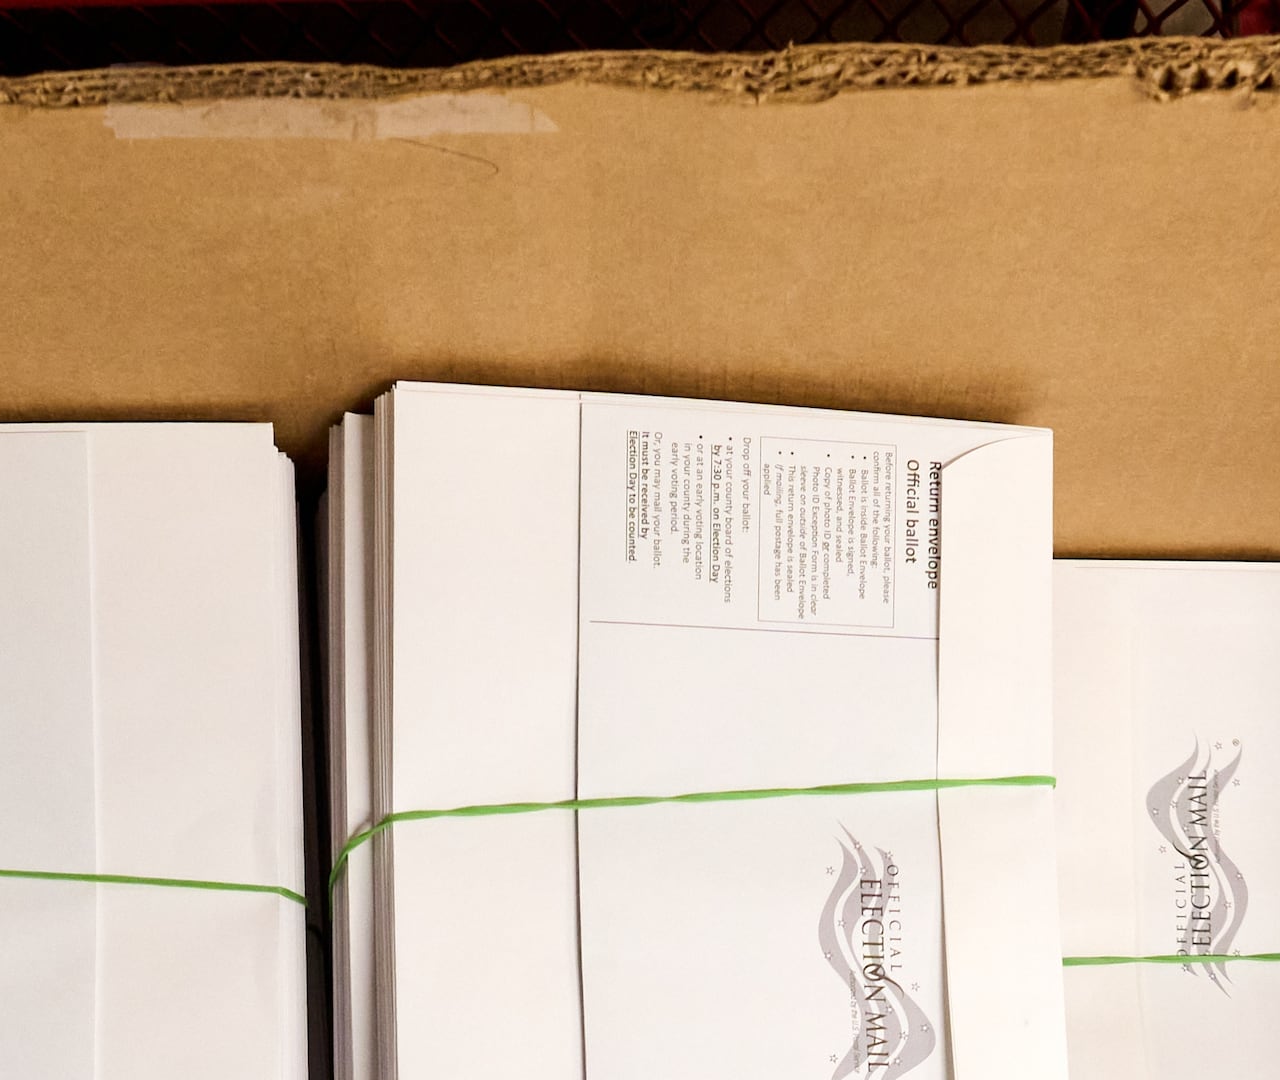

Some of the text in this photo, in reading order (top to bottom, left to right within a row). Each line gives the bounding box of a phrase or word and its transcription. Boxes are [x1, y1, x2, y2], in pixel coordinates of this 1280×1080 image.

[904, 459, 920, 563] Official ballot
[886, 864, 903, 973] OFFICIAL
[1188, 769, 1212, 948] ELECTION MAIL
[859, 878, 890, 1073] ELECTION MAIL
